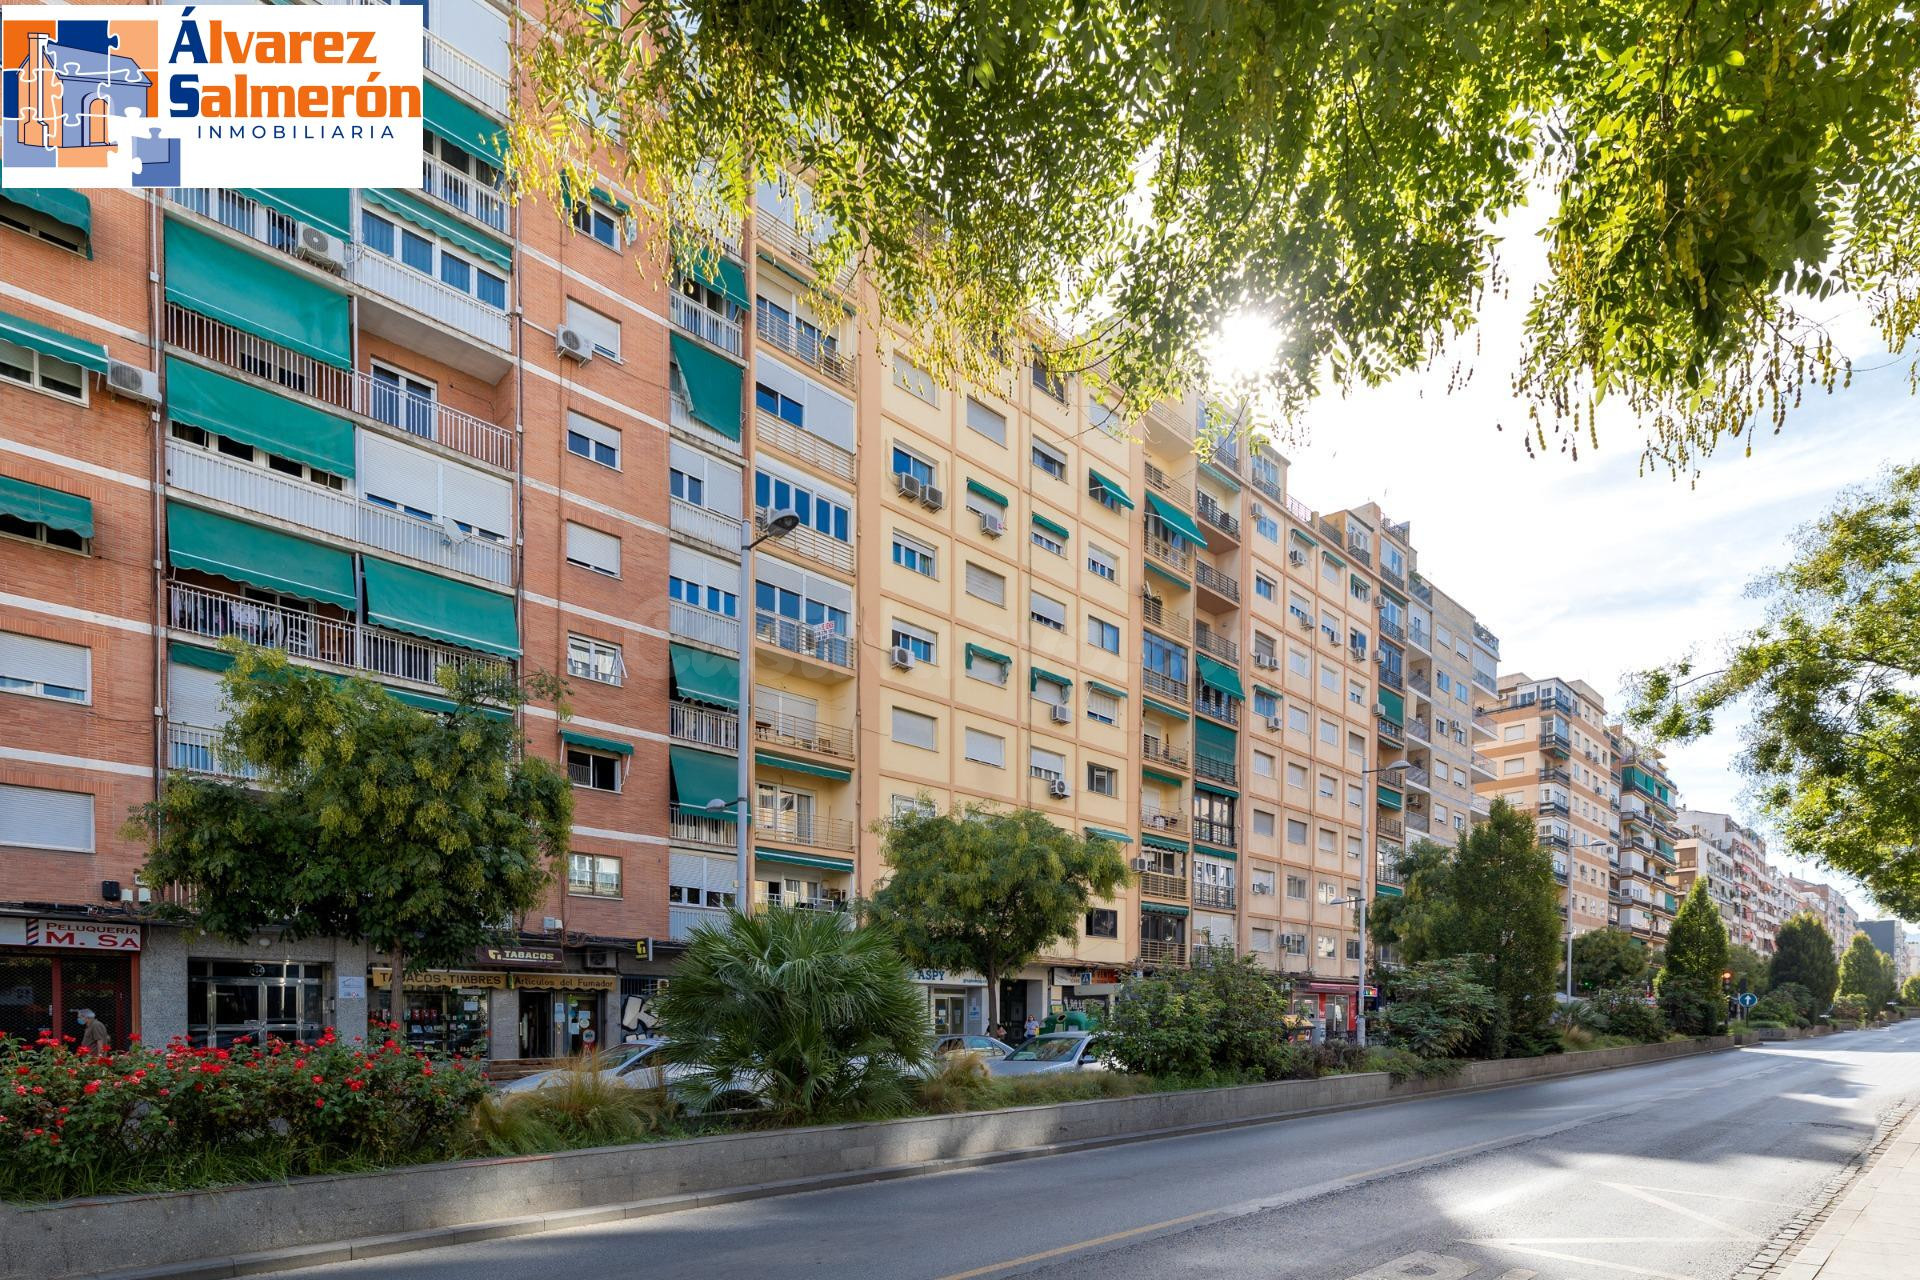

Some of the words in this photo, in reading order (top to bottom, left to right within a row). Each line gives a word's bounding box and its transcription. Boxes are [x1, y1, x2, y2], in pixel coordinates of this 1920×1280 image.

[46, 931, 85, 946] M.
[98, 934, 139, 948] SA
[504, 950, 555, 960] TABACOS
[380, 972, 441, 983] TACOS
[448, 974, 502, 985] TIMBRES
[918, 969, 945, 981] ASPY
[560, 978, 573, 986] del
[577, 978, 613, 987] Fumador
